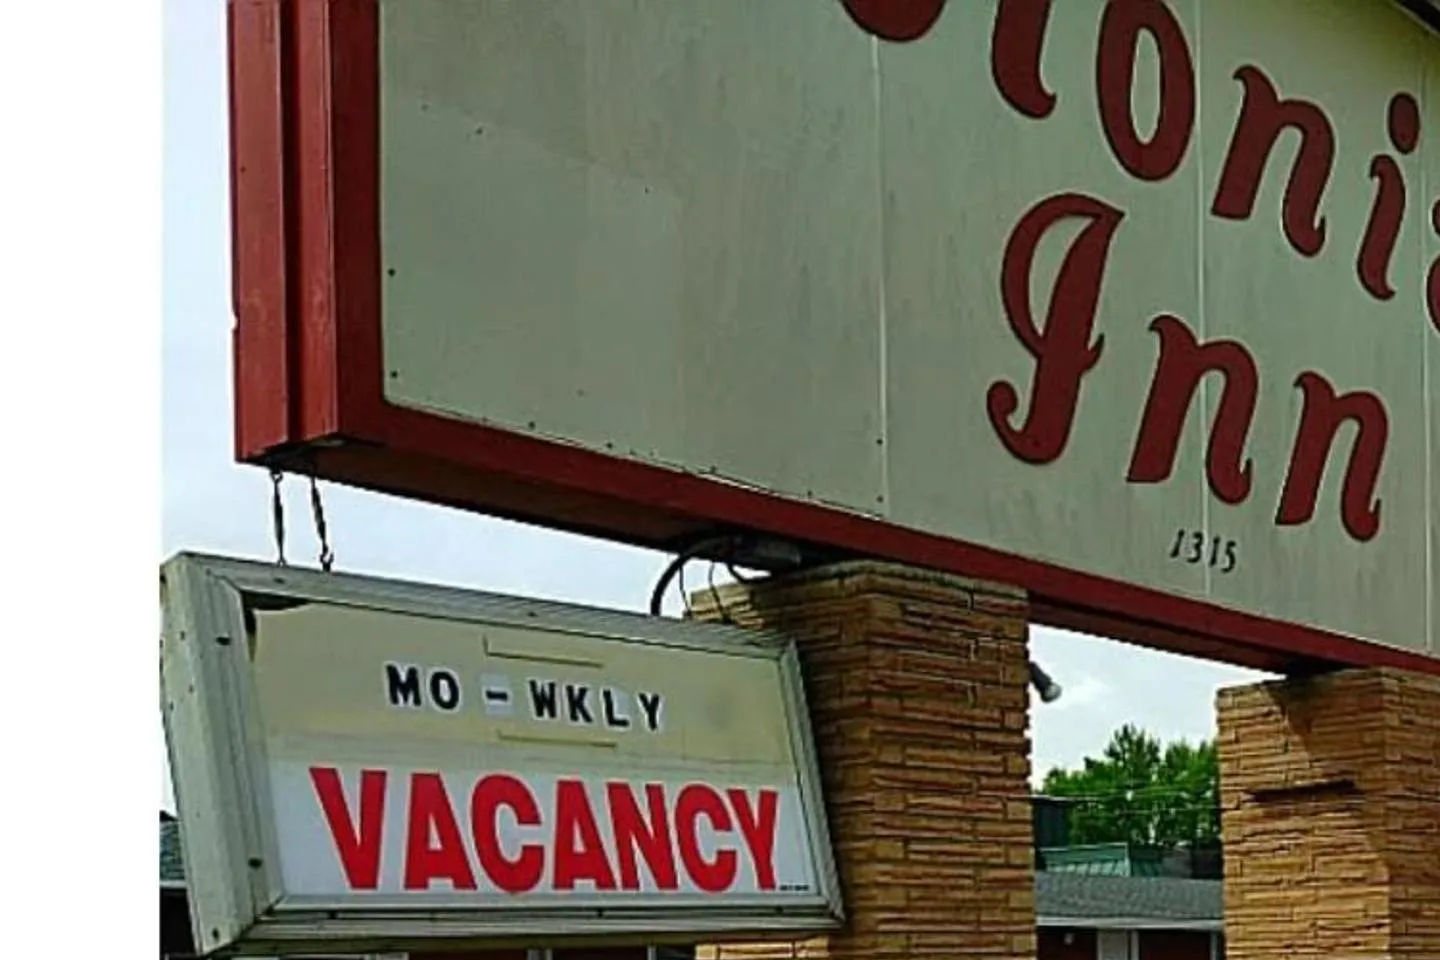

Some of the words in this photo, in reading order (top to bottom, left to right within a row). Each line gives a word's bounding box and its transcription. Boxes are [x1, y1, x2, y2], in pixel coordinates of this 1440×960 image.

[986, 192, 1389, 542] Inn
[1169, 528, 1237, 574] 1315
[309, 765, 779, 895] VACANCY
